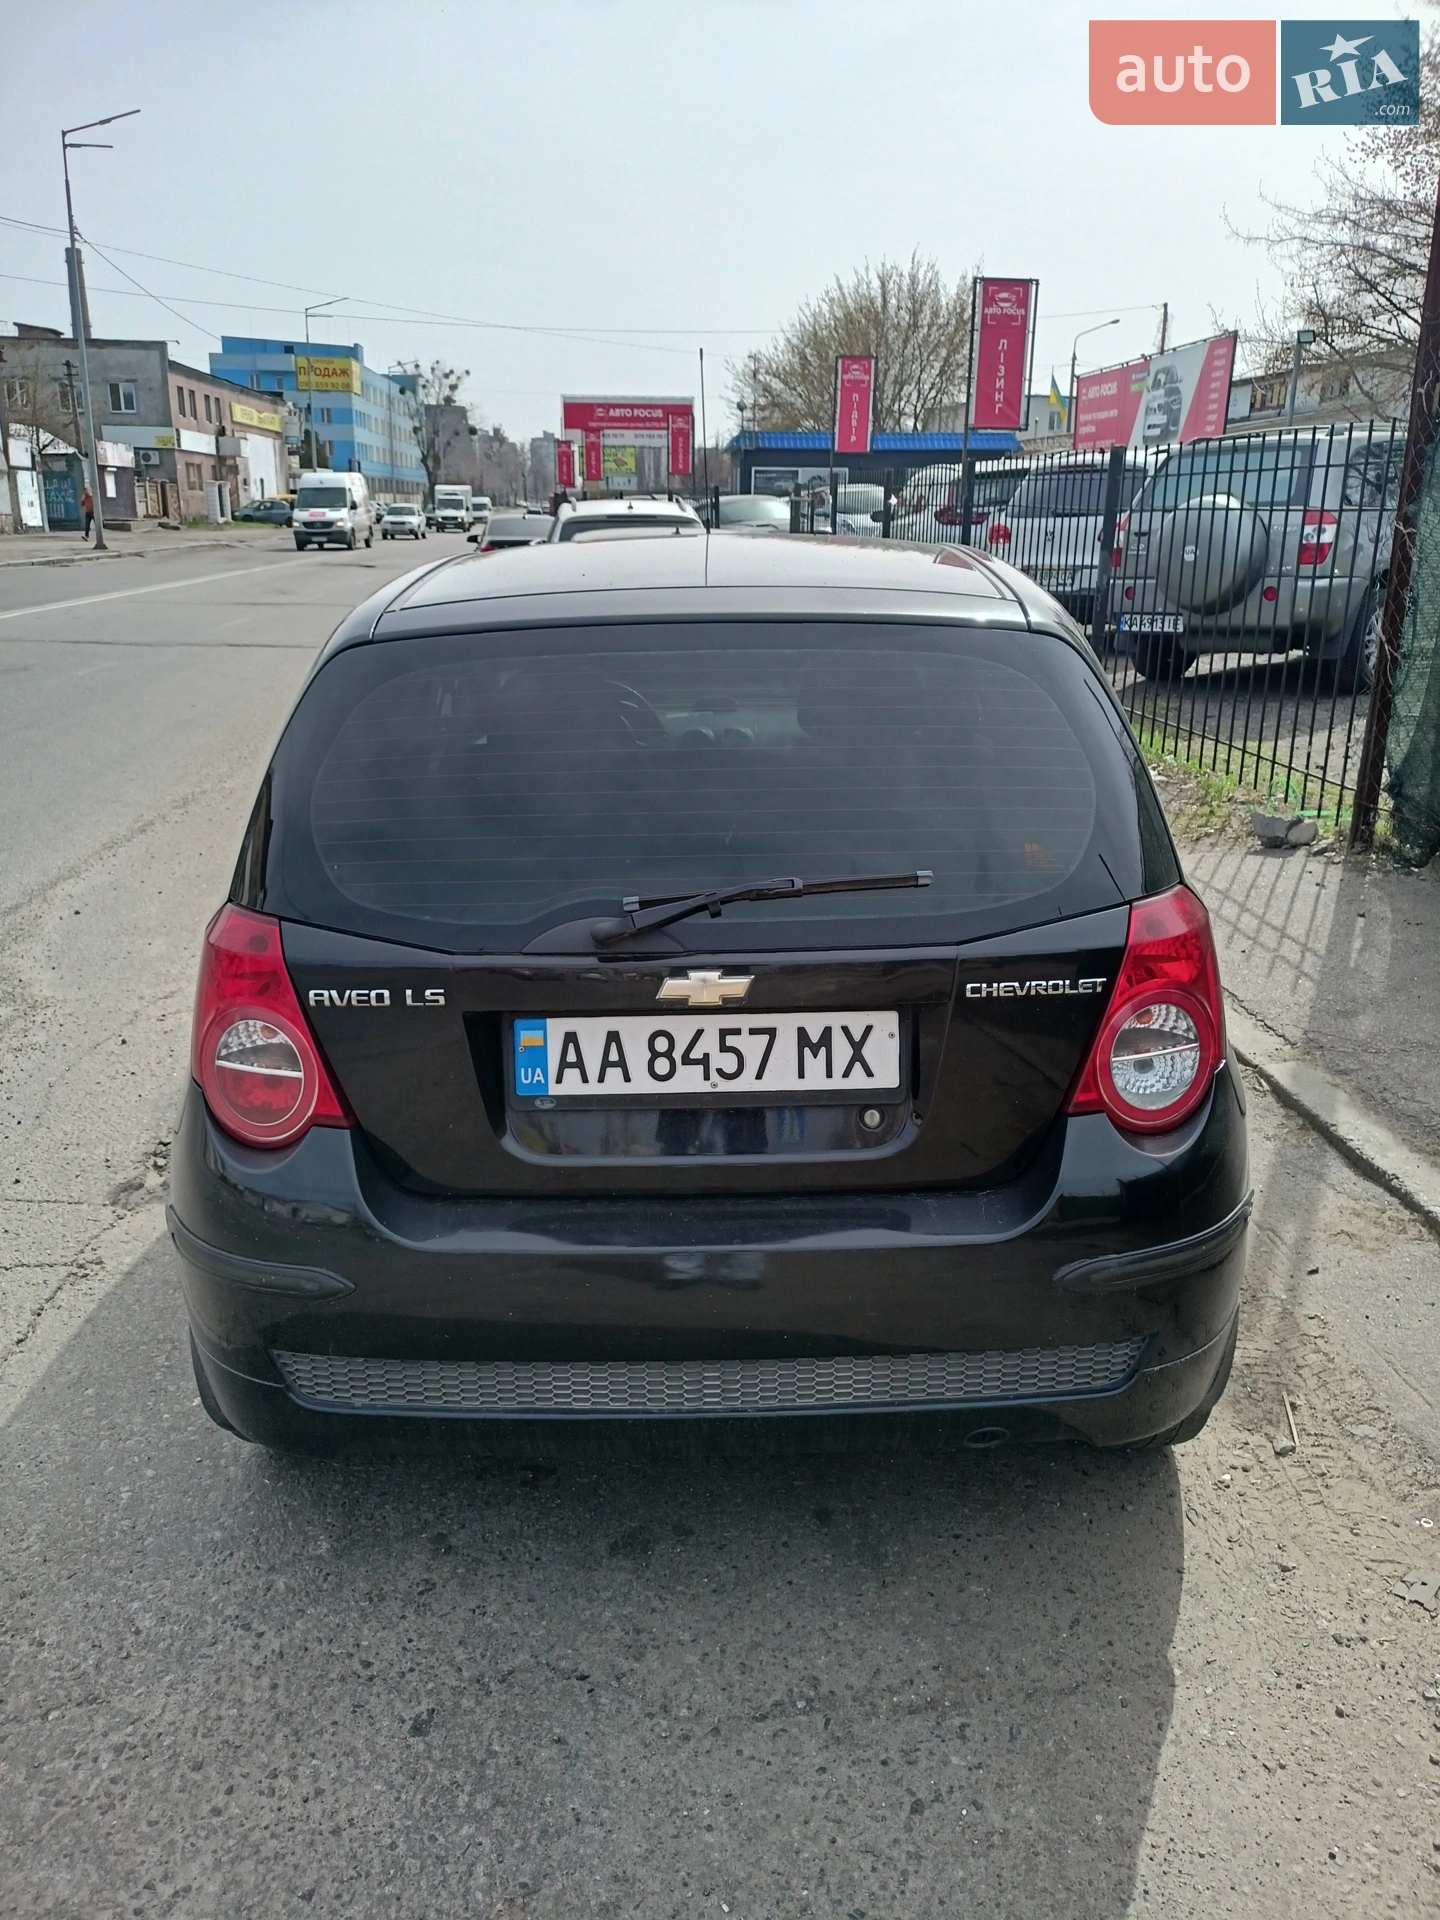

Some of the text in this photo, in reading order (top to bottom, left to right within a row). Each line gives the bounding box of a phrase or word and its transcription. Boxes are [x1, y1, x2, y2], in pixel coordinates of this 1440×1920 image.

[1003, 307, 1025, 315] FOCUS
[299, 366, 350, 379] ПРОДАЖ
[995, 339, 1008, 415] ЛІЗИНГ
[609, 408, 663, 418] АВТО FOCUS
[966, 978, 1107, 998] CHEVROLET
[308, 989, 446, 1007] AVEO LS
[555, 1025, 875, 1084] AA 8457 MX
[520, 1067, 545, 1084] UA
